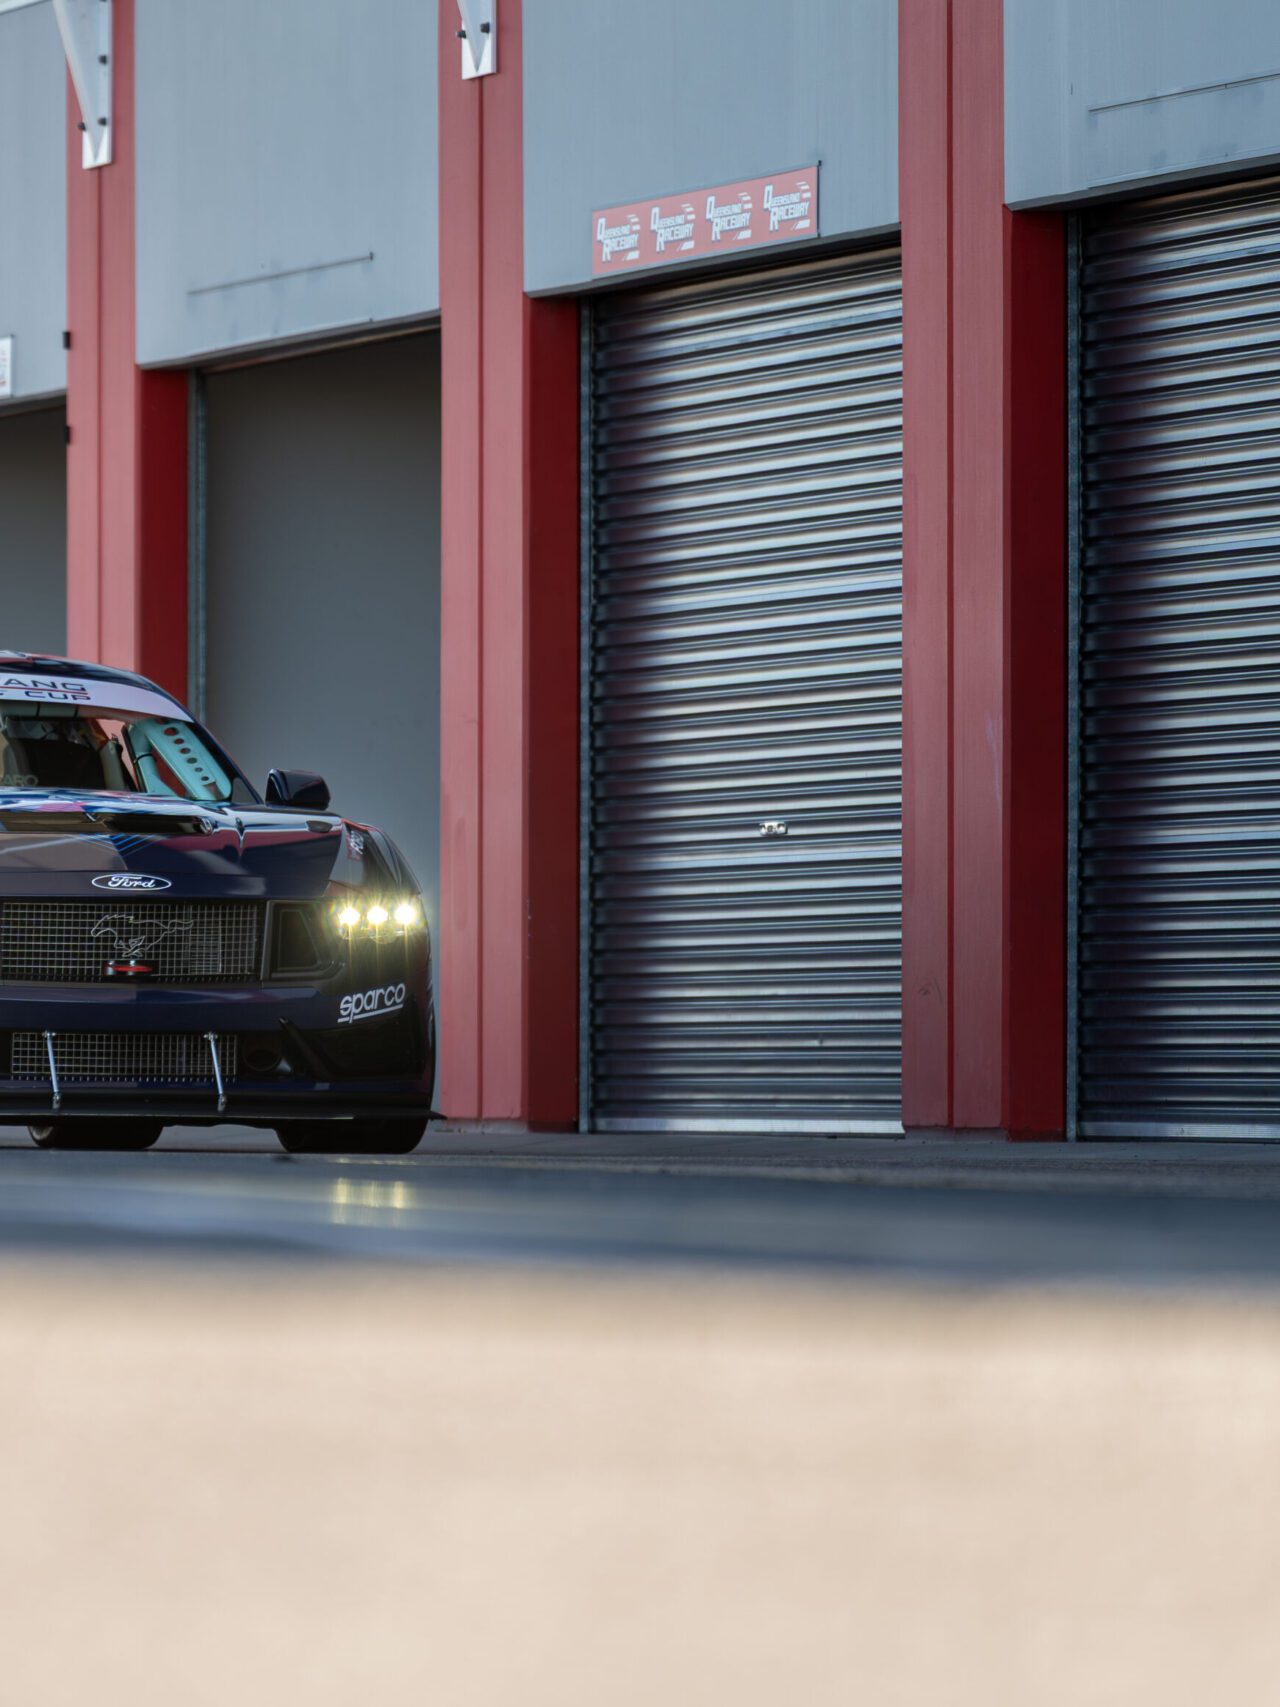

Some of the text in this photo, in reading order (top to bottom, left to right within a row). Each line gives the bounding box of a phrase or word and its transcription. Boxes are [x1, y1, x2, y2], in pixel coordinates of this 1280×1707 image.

[711, 212, 751, 241] RACEWAY
[769, 201, 810, 231] RACEWAY
[602, 234, 638, 262] RACEWAY
[656, 223, 695, 252] RACEWAY
[25, 690, 92, 701] CUP
[107, 875, 156, 888] Ford
[342, 983, 406, 1024] sparco
